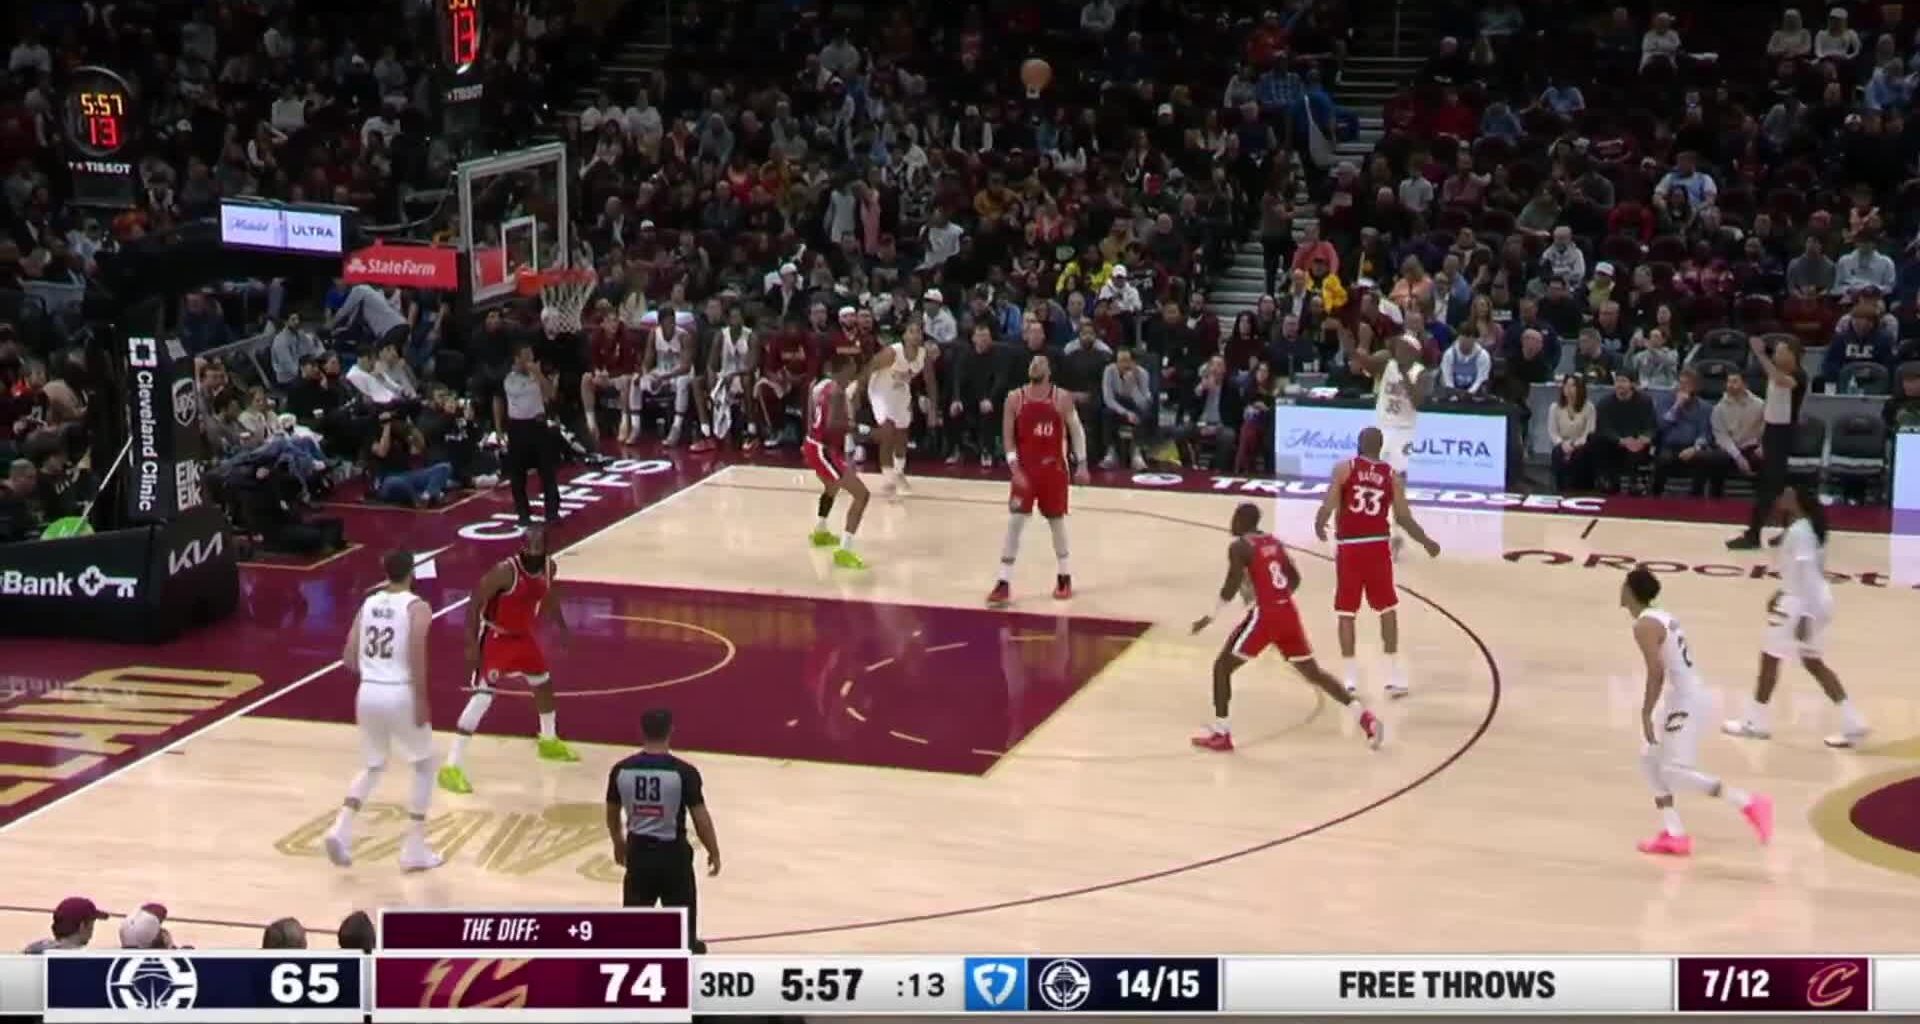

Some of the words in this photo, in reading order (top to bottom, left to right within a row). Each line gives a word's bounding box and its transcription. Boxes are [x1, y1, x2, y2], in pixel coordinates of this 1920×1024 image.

[81, 93, 123, 116] 5:57
[90, 117, 118, 146] 13
[86, 162, 131, 175] TISSOT
[291, 223, 334, 238] ULTRA
[136, 370, 159, 459] Cleveland
[138, 461, 158, 512] Clinic
[1350, 485, 1385, 516] 33
[1268, 560, 1288, 590] 8
[364, 625, 395, 659] 32
[634, 775, 661, 802] 83
